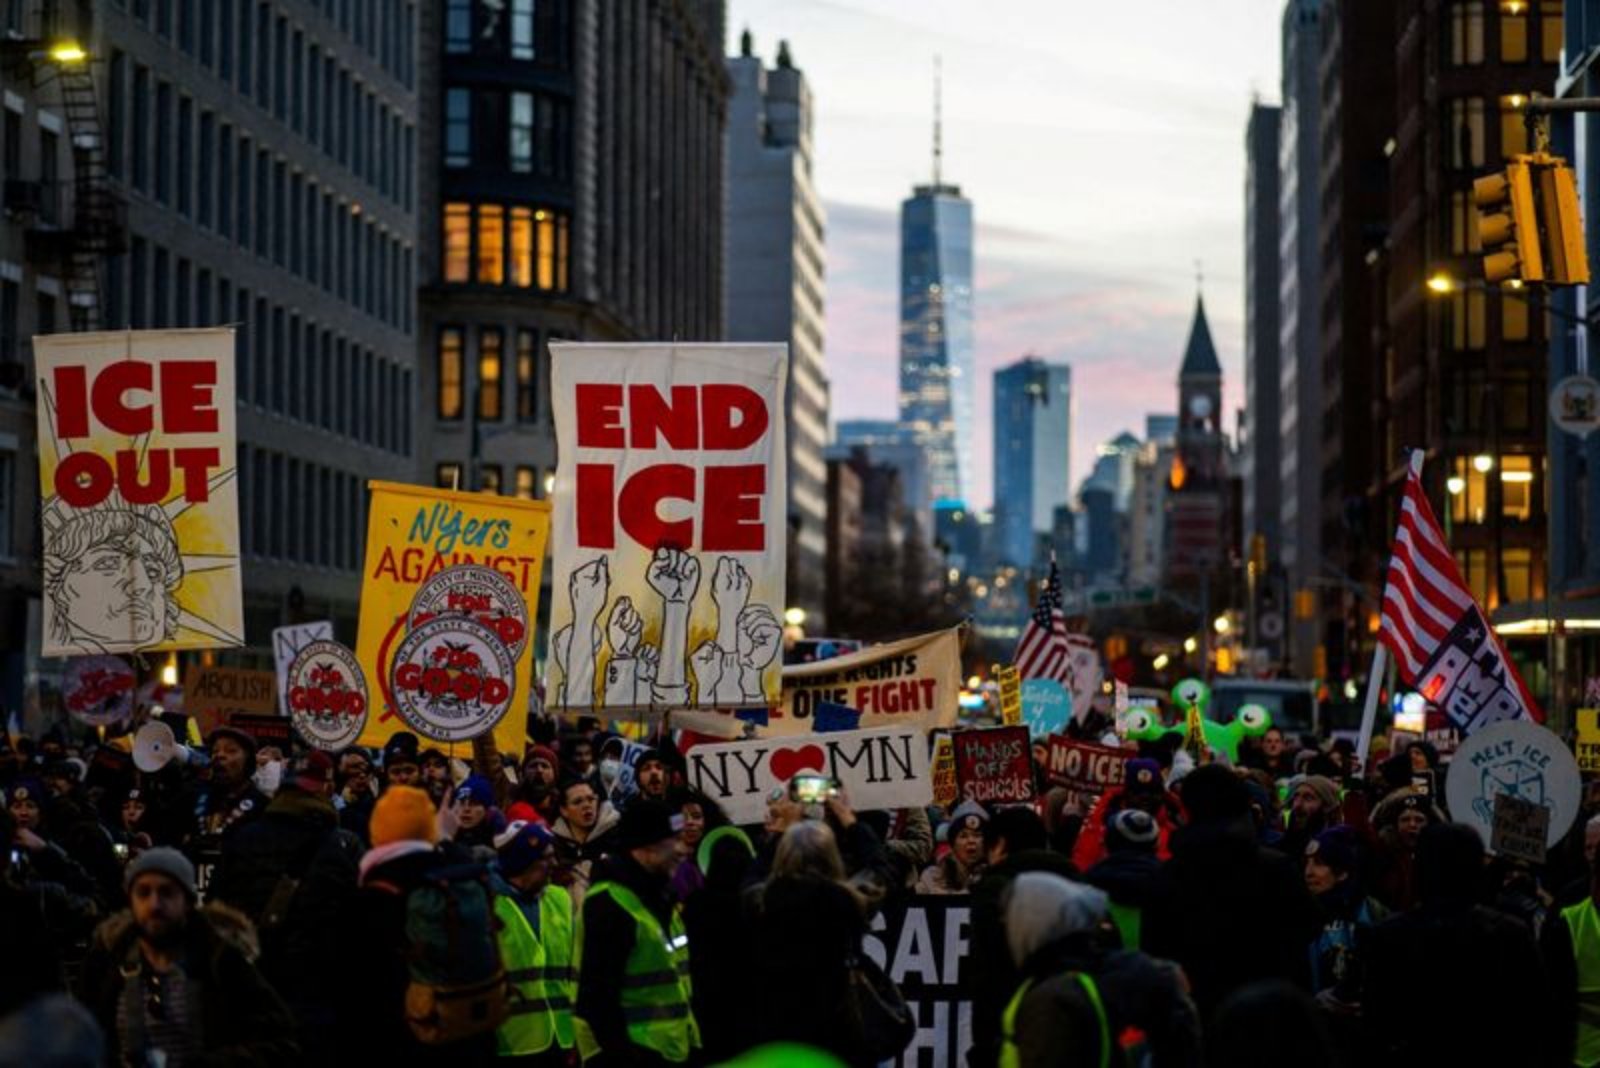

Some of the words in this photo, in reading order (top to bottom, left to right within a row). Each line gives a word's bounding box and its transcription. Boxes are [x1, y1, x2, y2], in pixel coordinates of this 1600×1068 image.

[54, 360, 219, 439] ICE
[576, 384, 768, 450] END
[54, 447, 220, 508] OUT
[576, 464, 766, 552] ICE
[431, 646, 481, 669] FOR
[193, 673, 271, 700] ABOLISH
[290, 685, 365, 717] GOOD
[396, 664, 508, 705] GOOD
[856, 678, 937, 714] FIGHT
[691, 748, 768, 797] NY
[826, 734, 917, 786] MN
[975, 761, 1009, 778] OFF
[1050, 743, 1082, 778] NO
[1471, 740, 1515, 767] MELT
[1523, 744, 1551, 768] ICE
[962, 772, 1032, 800] SCHOOLS
